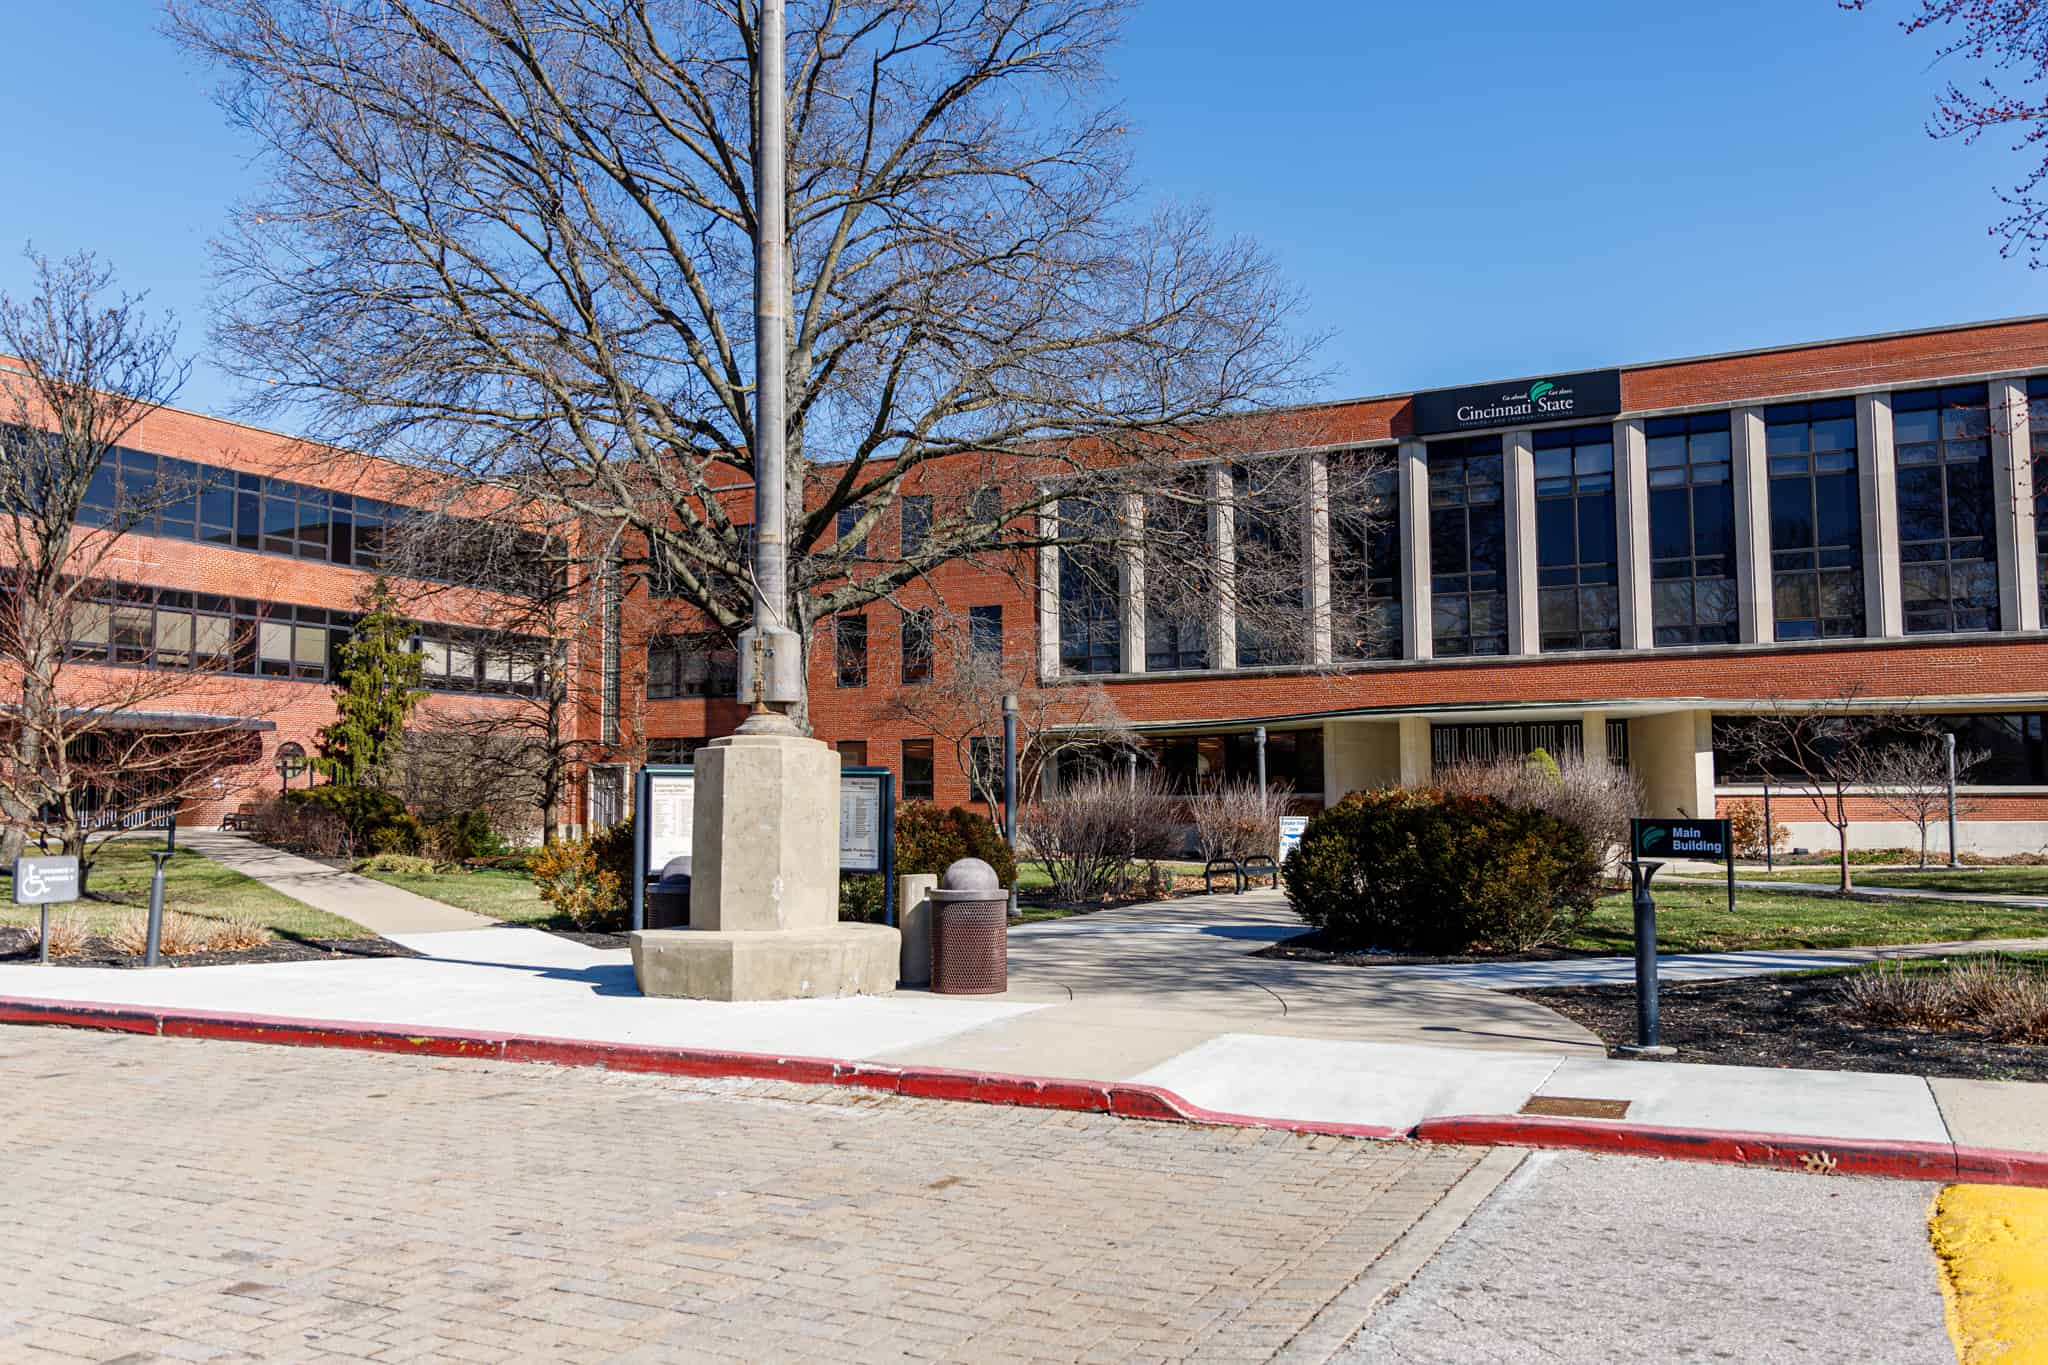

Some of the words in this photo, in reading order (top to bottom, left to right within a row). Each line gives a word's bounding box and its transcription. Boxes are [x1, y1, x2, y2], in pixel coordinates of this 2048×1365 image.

[1457, 399, 1532, 421] Cincinnati
[1537, 397, 1574, 413] State
[1672, 827, 1701, 838] Main
[1672, 840, 1722, 854] Building
